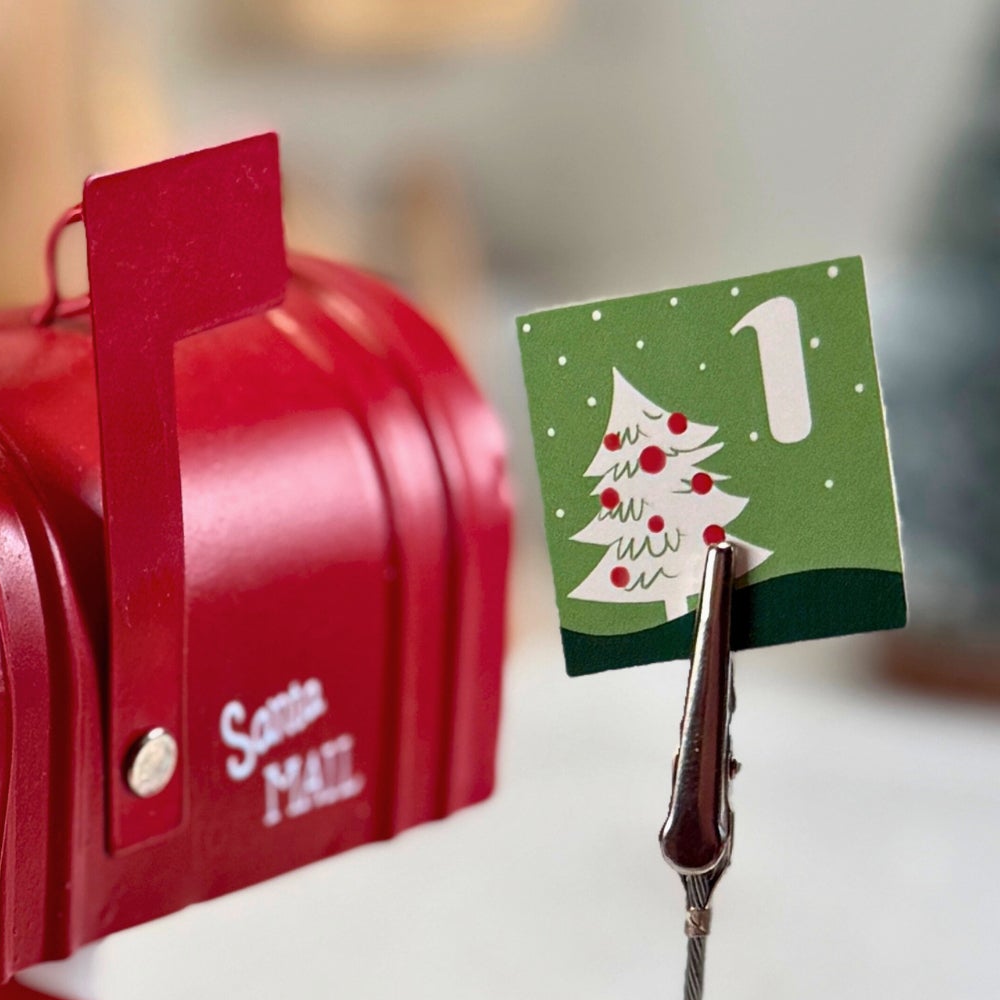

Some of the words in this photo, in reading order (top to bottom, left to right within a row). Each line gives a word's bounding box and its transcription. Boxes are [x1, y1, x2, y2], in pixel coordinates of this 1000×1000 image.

[729, 295, 813, 444] 1
[219, 677, 328, 781] Santa
[262, 732, 366, 828] MAIL
